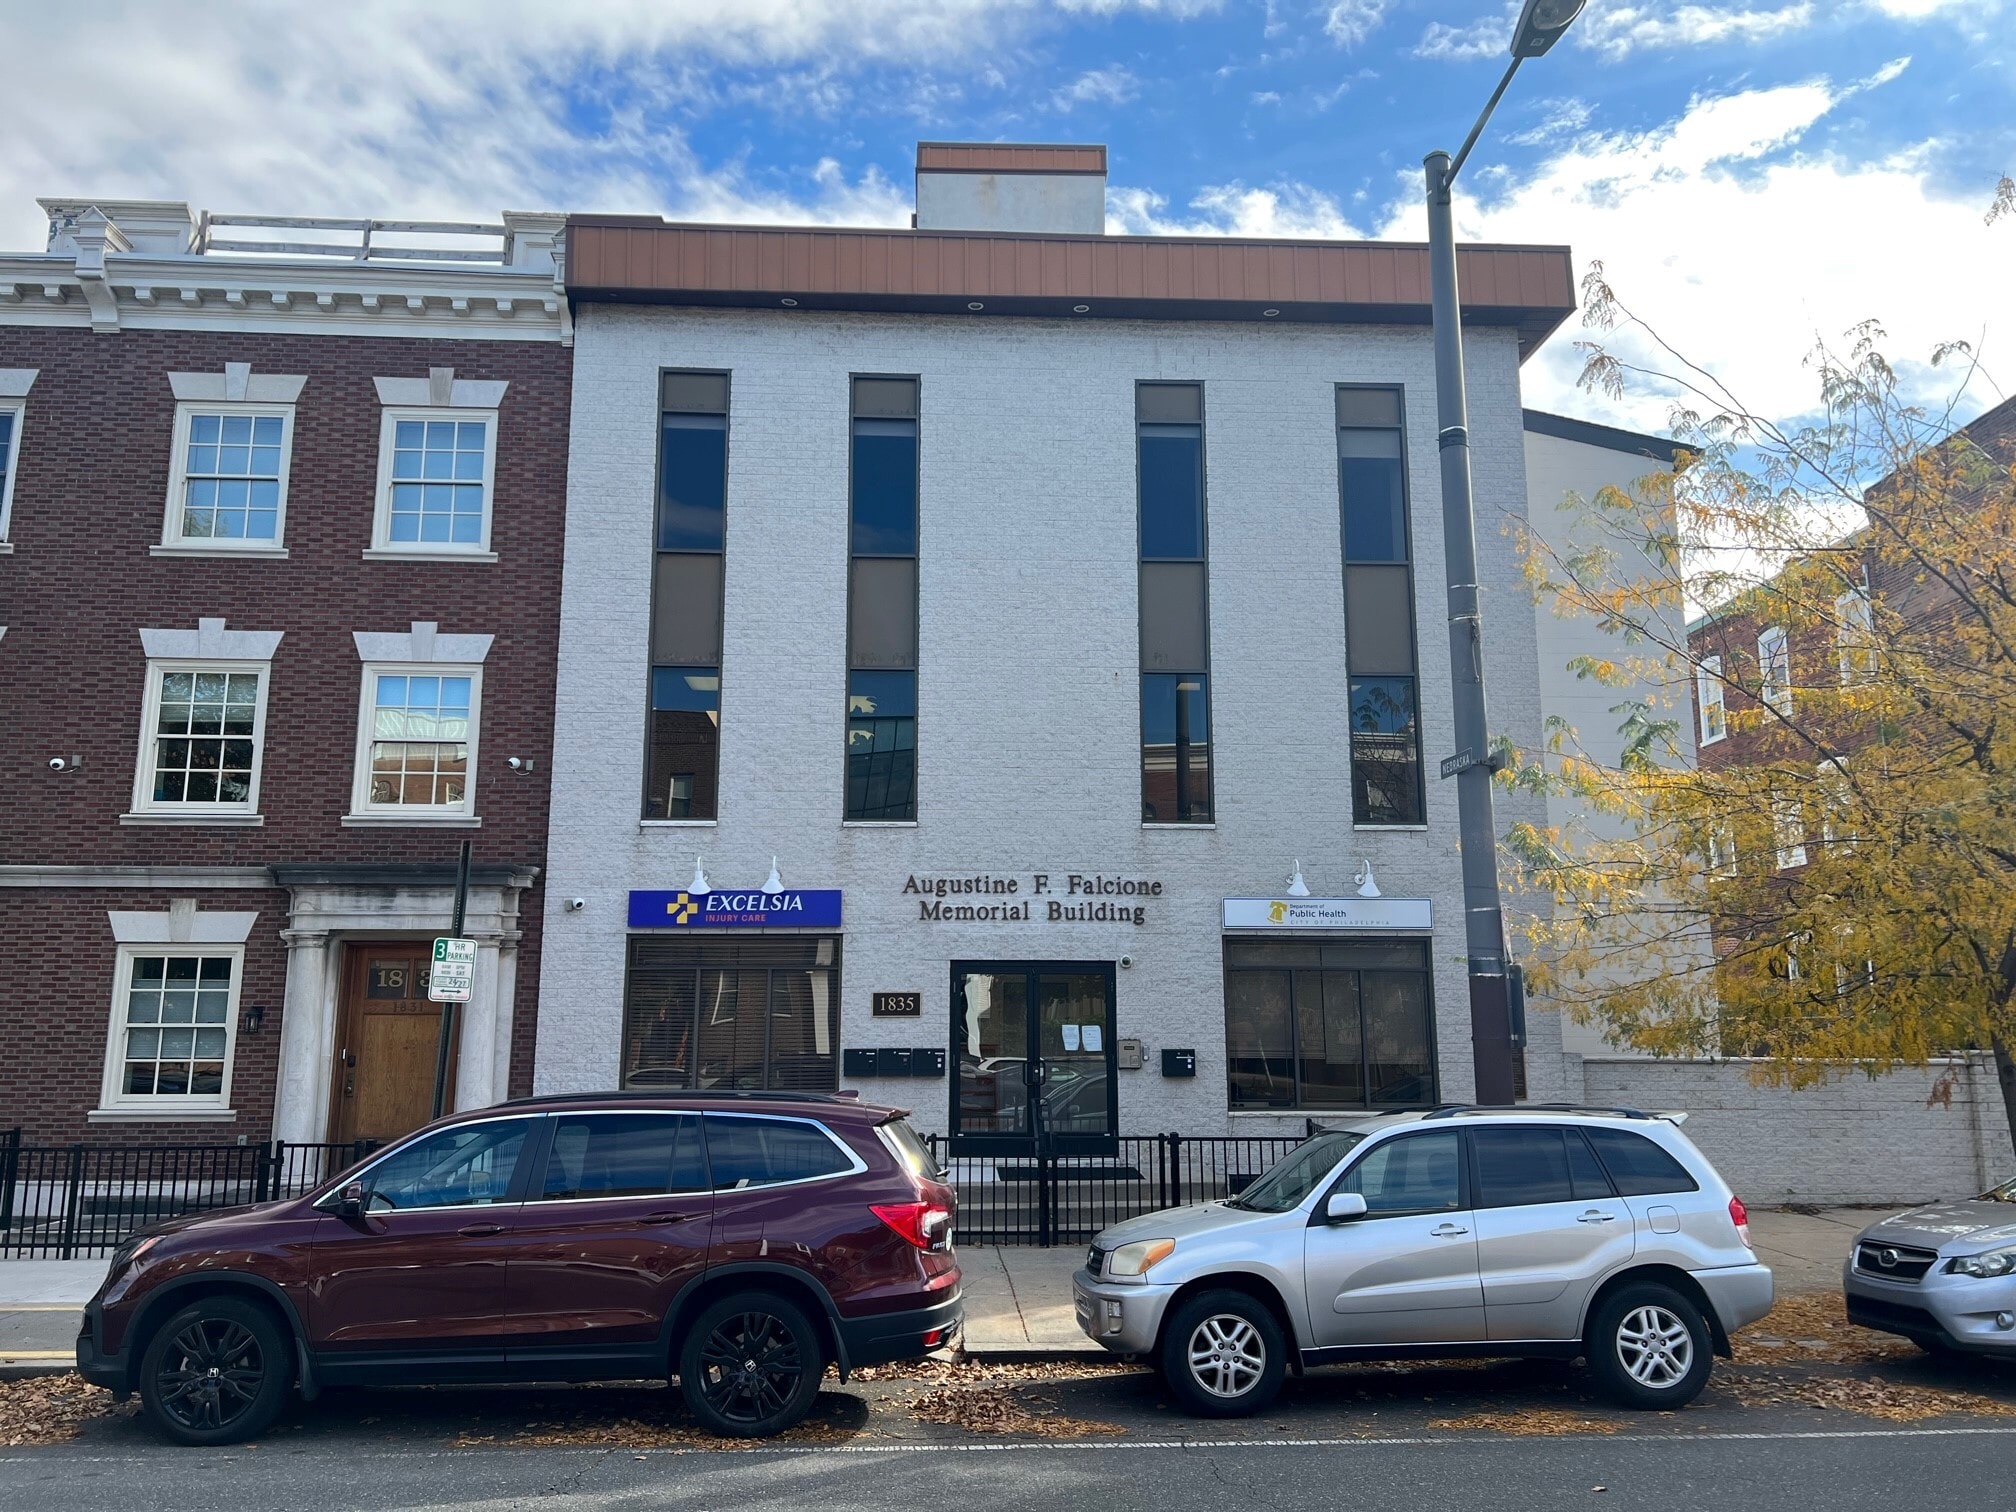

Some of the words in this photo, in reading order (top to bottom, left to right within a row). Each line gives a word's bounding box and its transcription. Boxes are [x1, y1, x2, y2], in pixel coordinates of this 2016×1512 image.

[1443, 754, 1470, 774] NEBRASKA
[902, 874, 1018, 897] Augustine
[1033, 875, 1052, 895] F.
[1067, 875, 1162, 895] Falcione
[706, 895, 803, 911] EXCELSIA
[705, 914, 738, 922] INJURY
[741, 914, 766, 922] CARE
[919, 901, 1030, 921] Memorial
[1047, 901, 1146, 926] Building
[1290, 910, 1316, 918] Public
[1318, 910, 1346, 918] Health
[436, 943, 445, 959] 3
[447, 952, 473, 961] PARKING
[377, 970, 403, 987] 18
[880, 996, 914, 1011] 1835
